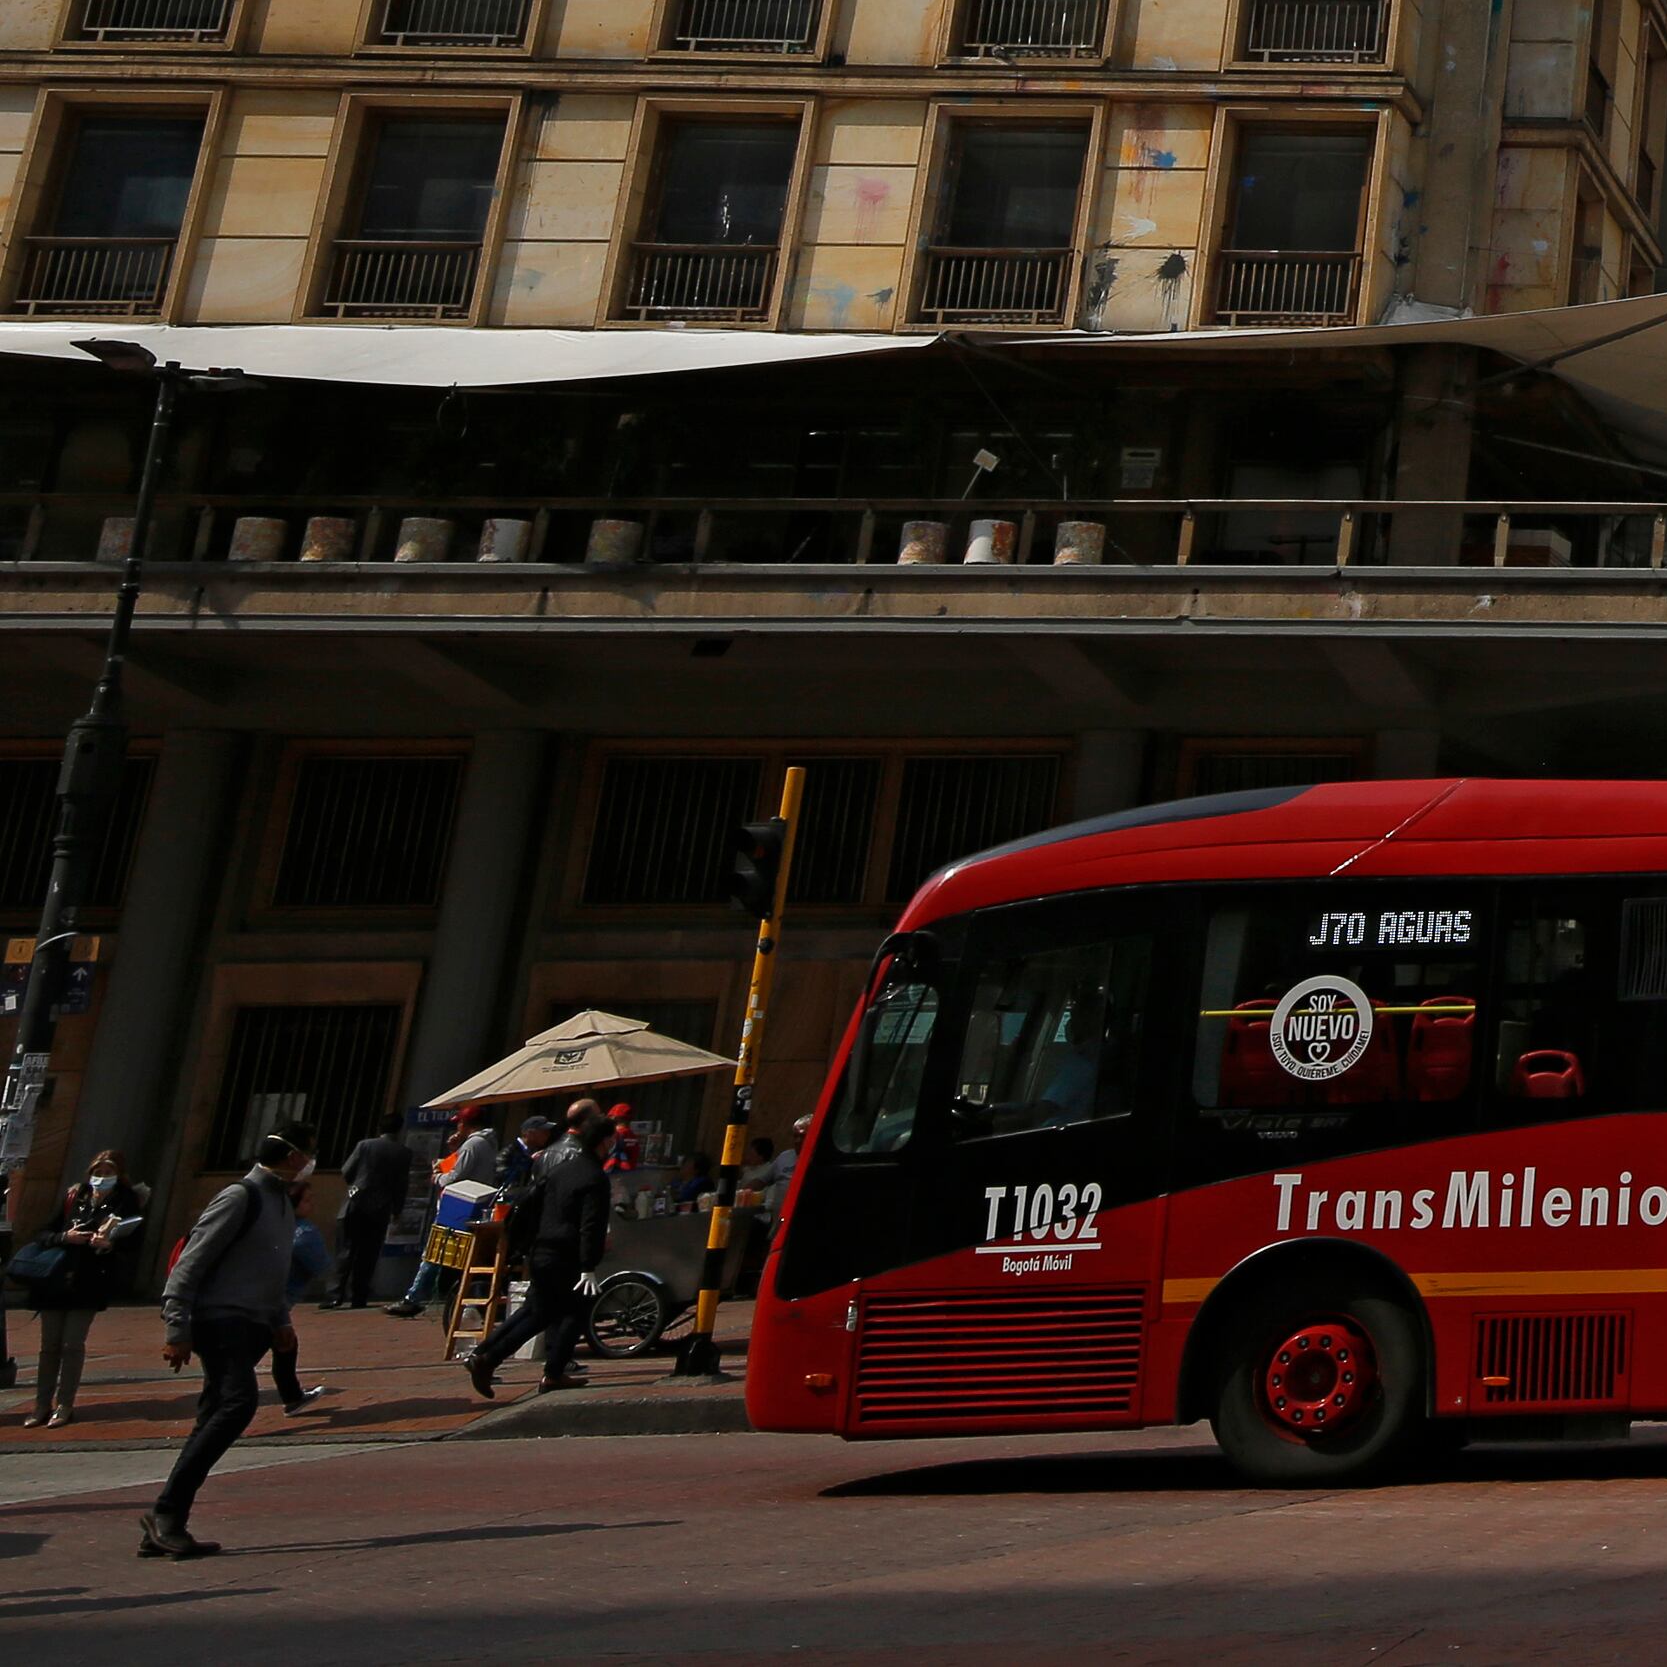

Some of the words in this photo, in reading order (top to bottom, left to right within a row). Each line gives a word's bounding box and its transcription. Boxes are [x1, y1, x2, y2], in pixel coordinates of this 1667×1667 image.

[1309, 912, 1366, 945] J70
[1377, 910, 1472, 944] AGUAS
[1308, 994, 1337, 1014] SOY
[1288, 1014, 1355, 1042] NUEVO
[1002, 1255, 1041, 1276] Bogotá
[1042, 1253, 1073, 1272] Móvil
